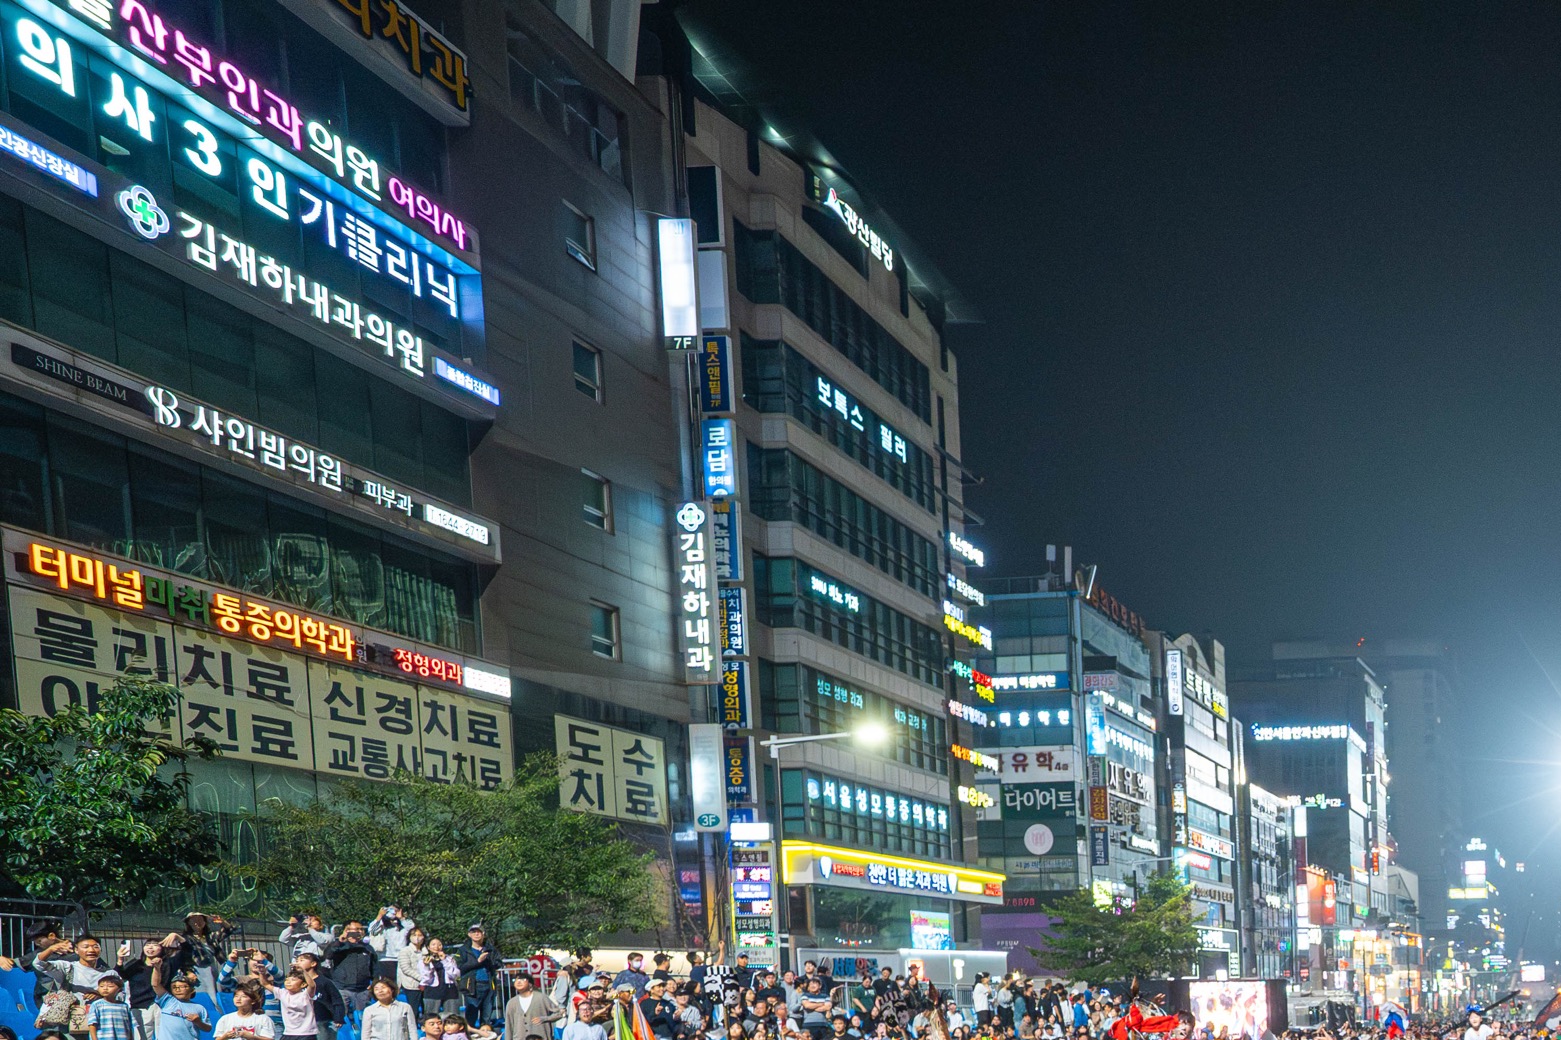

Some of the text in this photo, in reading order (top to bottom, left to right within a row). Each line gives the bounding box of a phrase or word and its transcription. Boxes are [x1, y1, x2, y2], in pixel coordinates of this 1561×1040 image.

[389, 177, 466, 250] 여의사
[177, 211, 424, 377] 김재하내과의원
[674, 338, 692, 349] 7F
[36, 356, 127, 400] SHINE BEAM
[818, 377, 906, 463] 보톡스 필러
[191, 406, 342, 492] 샤인빔의원
[365, 481, 413, 516] 피부과
[708, 427, 728, 472] 로담
[681, 532, 714, 672] 김재하내과
[35, 608, 294, 706] 물리치료
[396, 649, 462, 684] 정형외과
[324, 681, 501, 749] 신경치료
[328, 731, 501, 791] 교통사고치료
[568, 724, 655, 776] 도수
[570, 769, 658, 818] 치료
[702, 815, 716, 826] 3F
[1004, 787, 1075, 811] 다이어트
